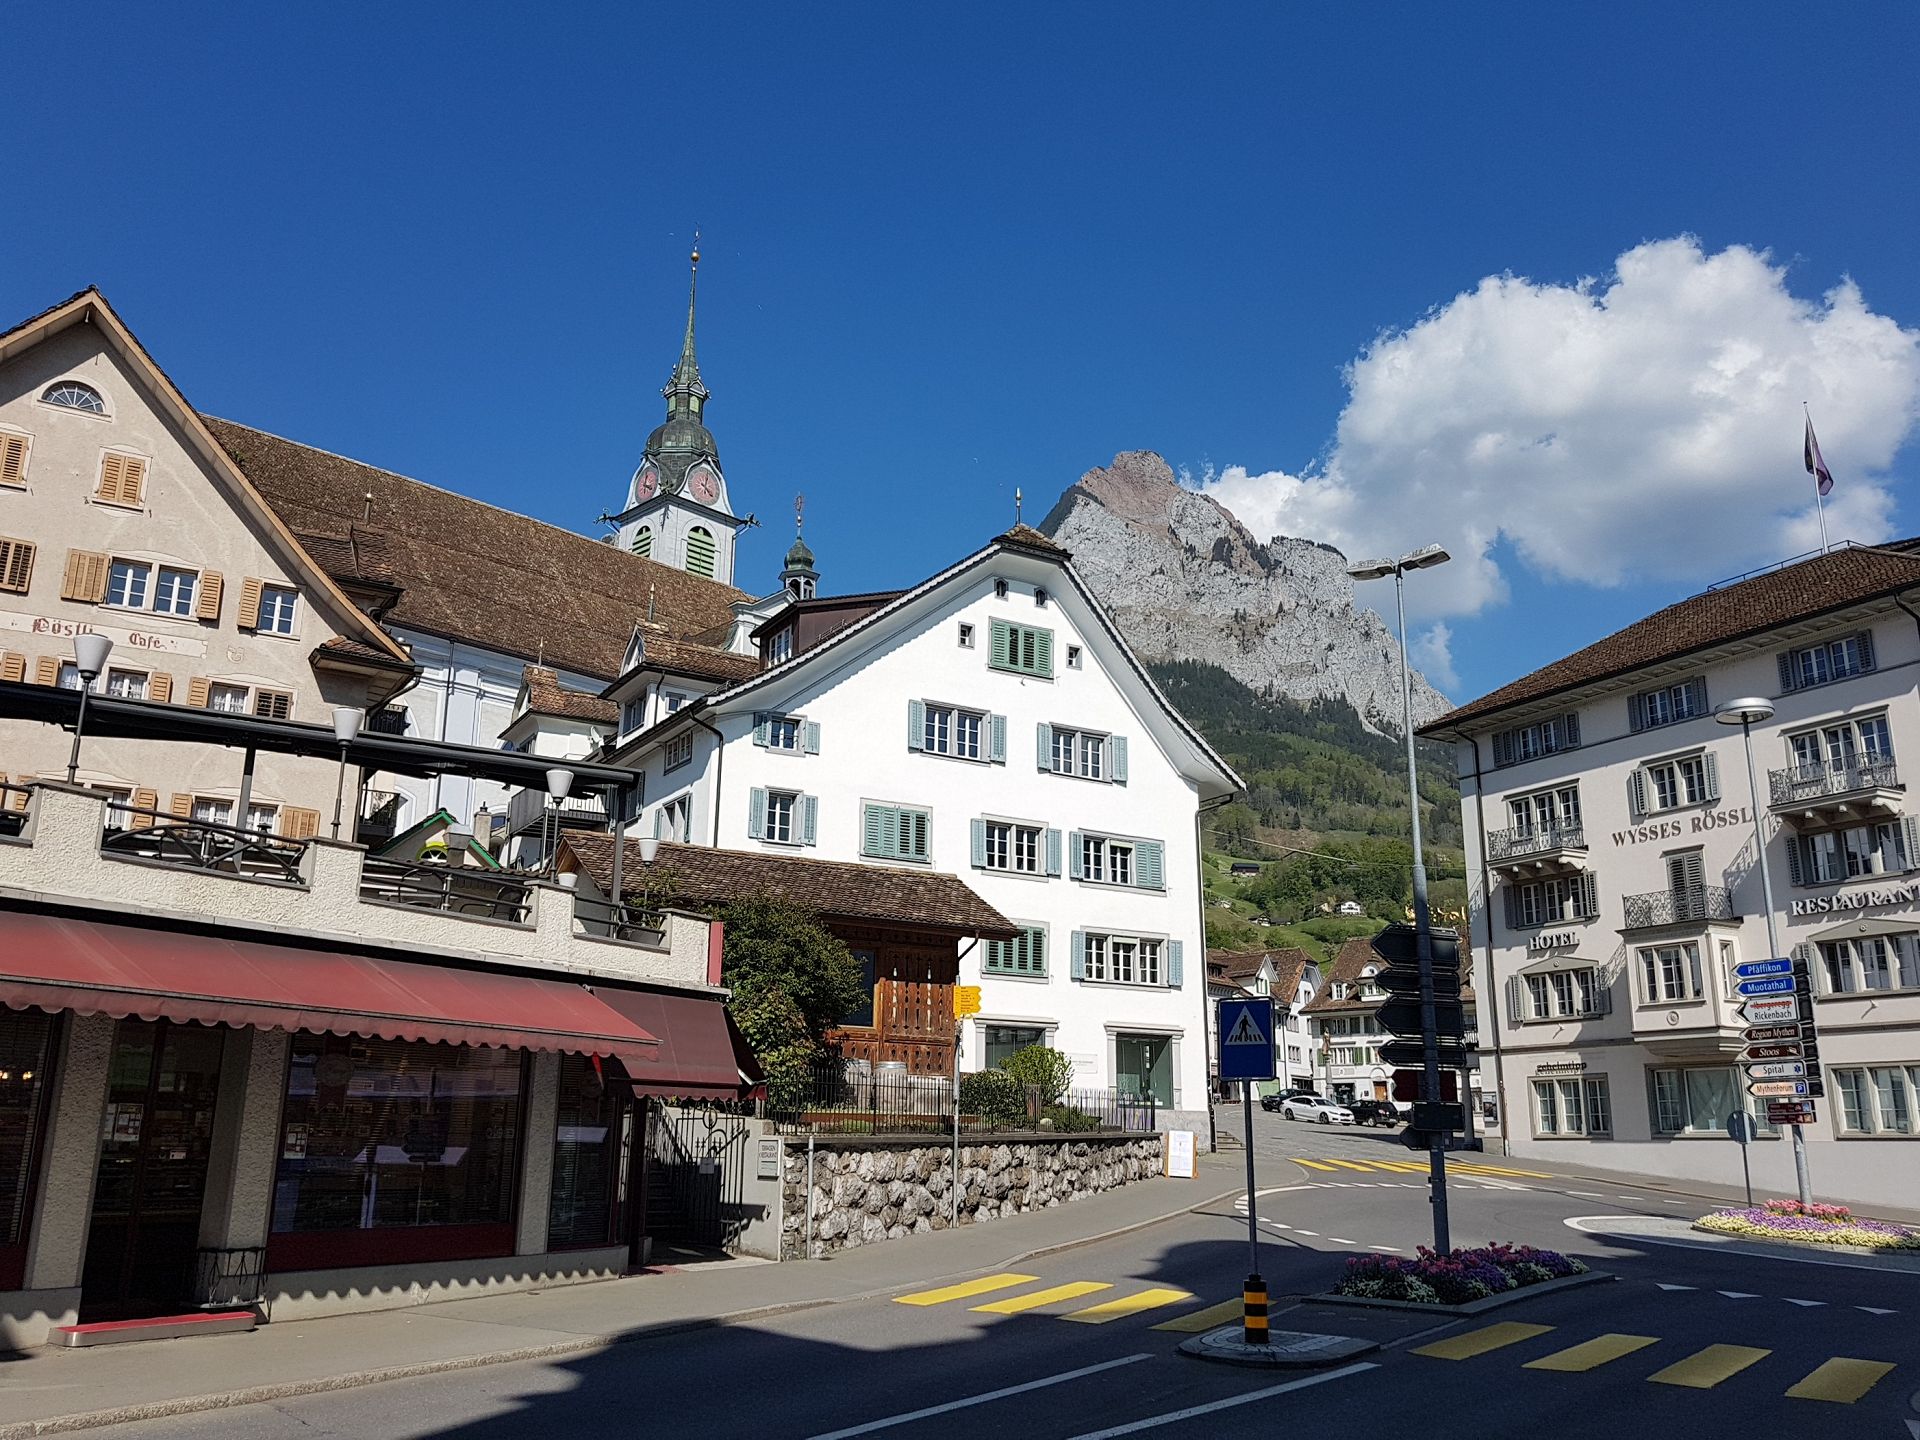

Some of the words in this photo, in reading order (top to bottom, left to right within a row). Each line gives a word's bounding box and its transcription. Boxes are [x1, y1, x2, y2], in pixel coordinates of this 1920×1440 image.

[129, 632, 160, 649] Café
[1612, 820, 1681, 847] WYSSES
[1691, 807, 1755, 833] RÖSSL
[1530, 932, 1579, 950] HOTEL
[1747, 964, 1782, 974] Pfäffikon
[1747, 980, 1787, 992] Muotathal
[1754, 1010, 1792, 1020] Rickenbach
[1751, 1030, 1772, 1040] Region
[1773, 1028, 1795, 1038] Mythen
[1759, 1048, 1780, 1057] Stoos
[1763, 1065, 1785, 1075] Spital
[1756, 1085, 1794, 1094] MythenForum
